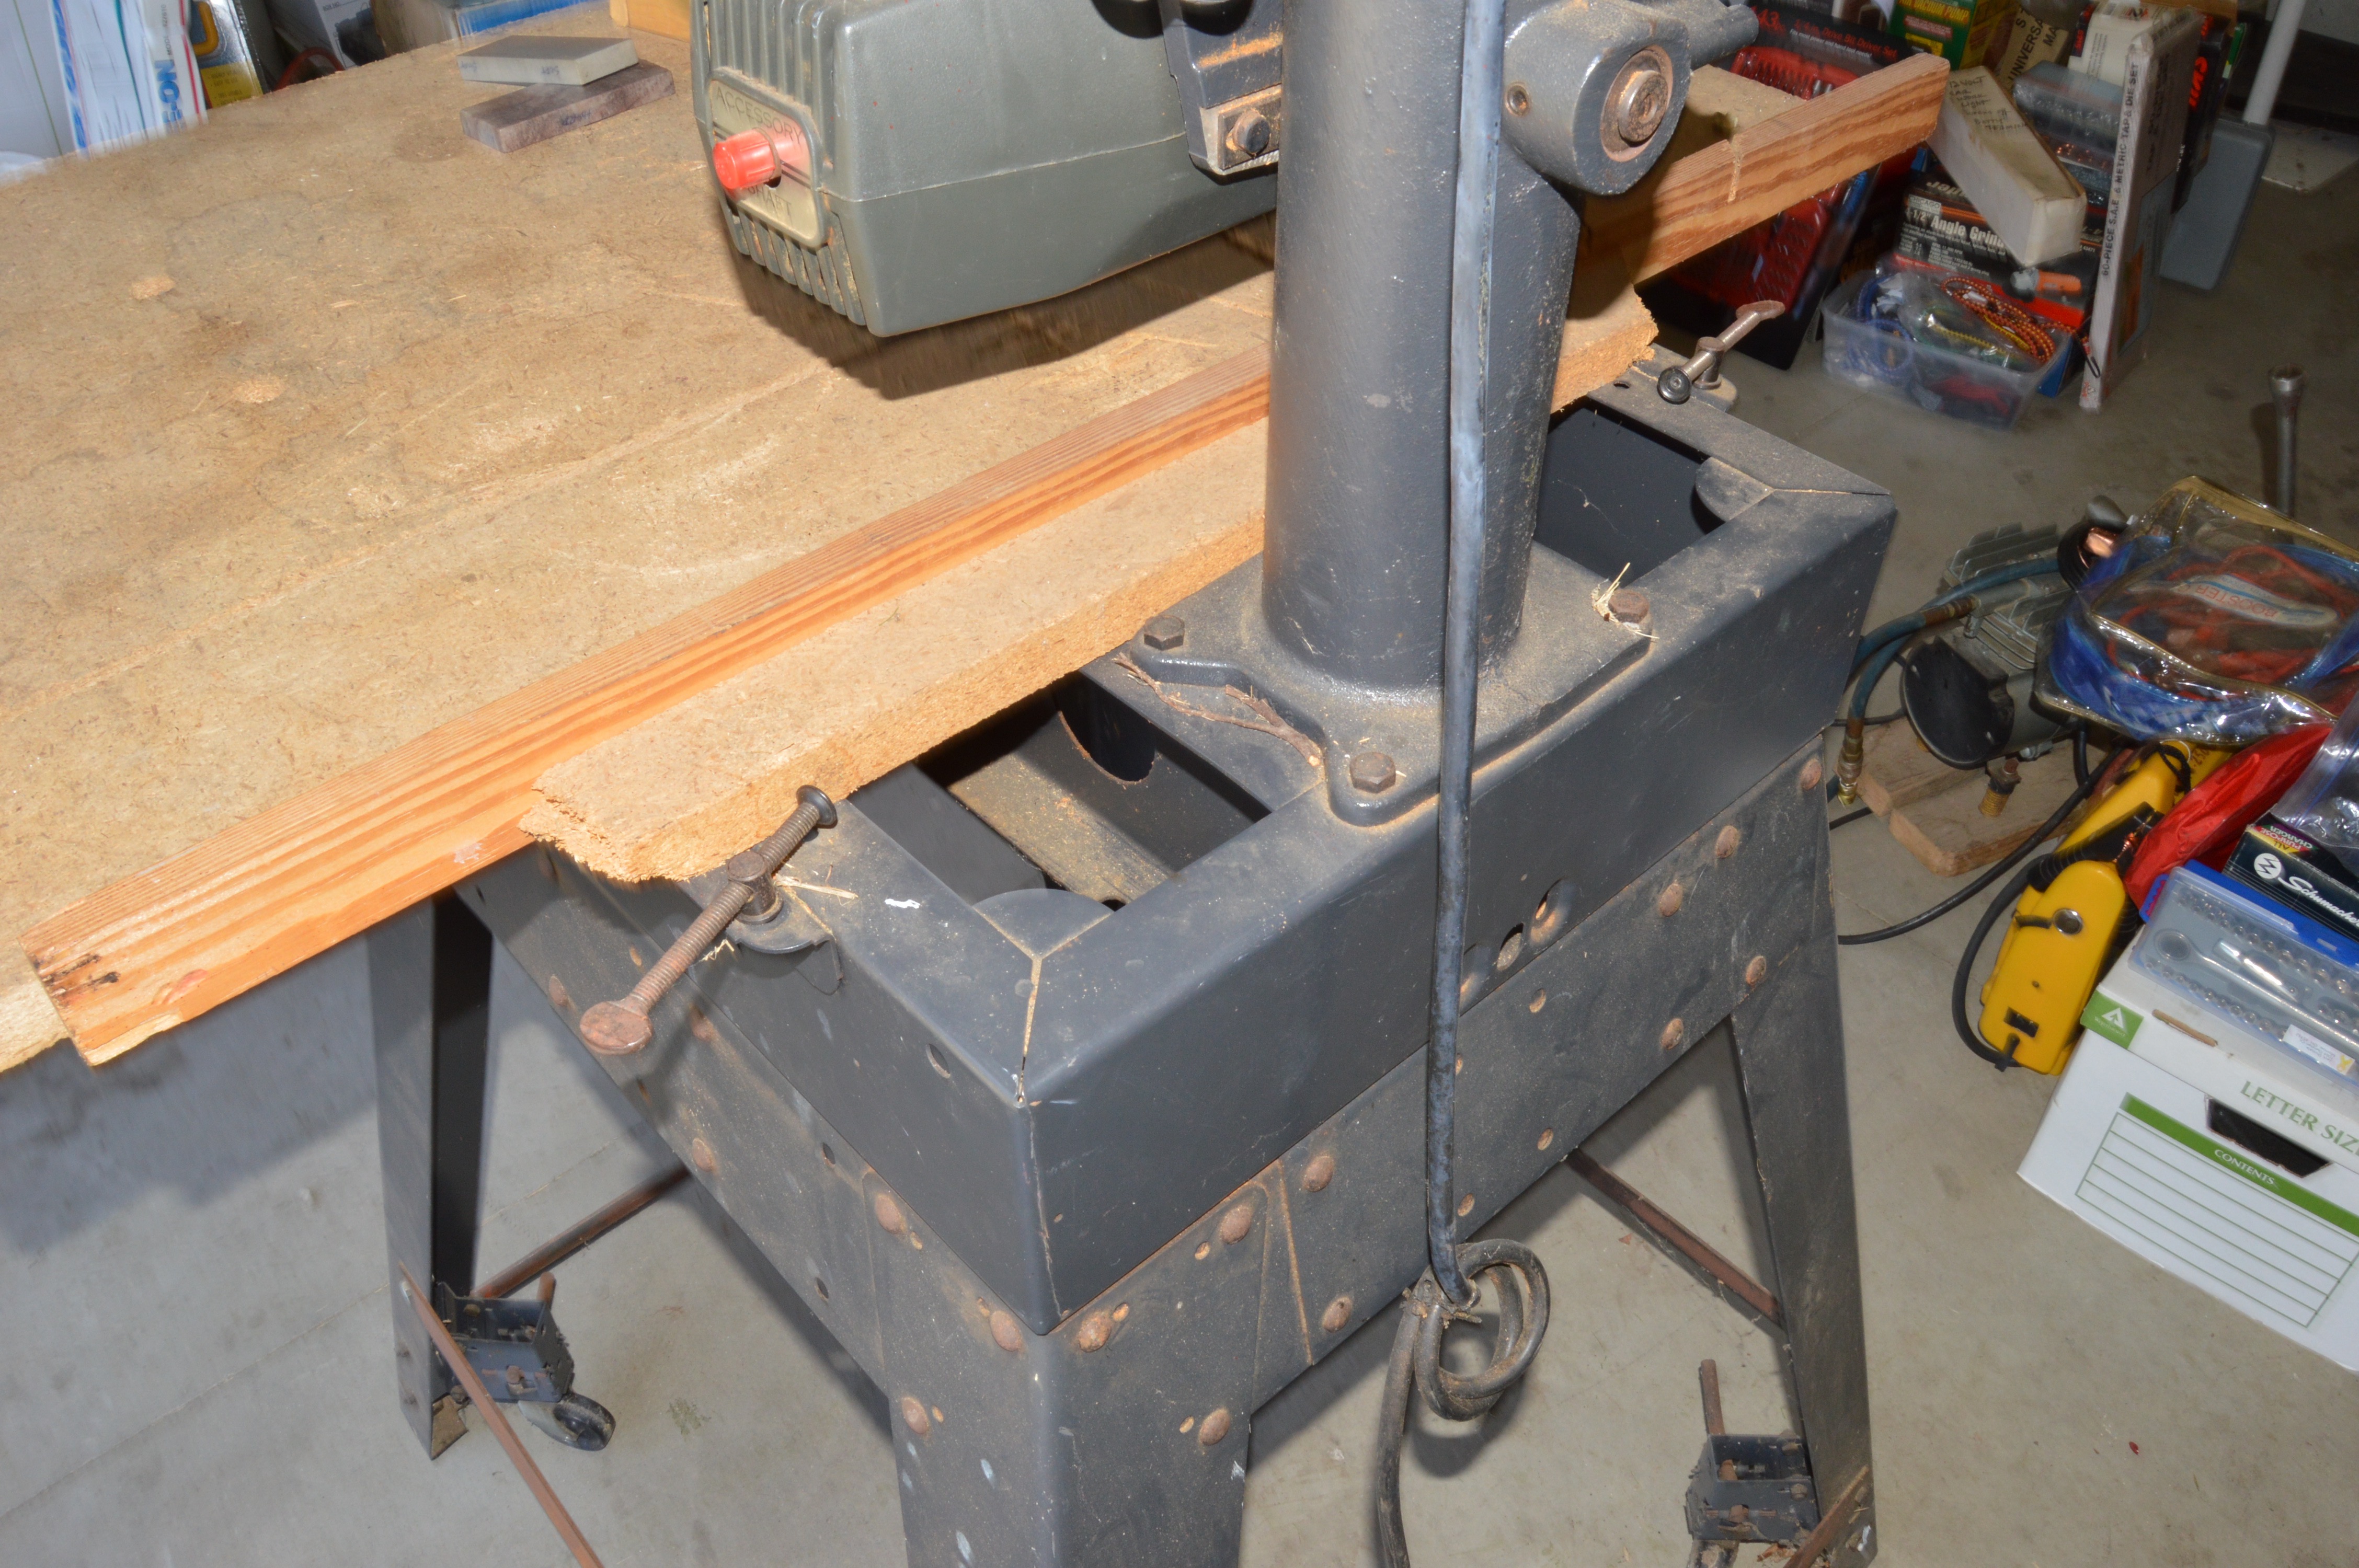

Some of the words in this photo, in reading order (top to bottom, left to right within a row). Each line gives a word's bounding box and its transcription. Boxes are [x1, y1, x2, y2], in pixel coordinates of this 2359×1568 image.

[1914, 0, 1945, 16] VACUUM
[1944, 6, 1969, 22] PUMP
[1823, 28, 1844, 40] Drive
[1845, 34, 1857, 44] Bit
[1858, 39, 1882, 51] Driver
[1883, 47, 1898, 57] Set
[2128, 63, 2139, 85] SET
[2124, 87, 2135, 106] DIE
[716, 87, 803, 144] ACCESSORY
[2114, 143, 2128, 183] METRIC
[748, 186, 792, 216] SHAFT
[1910, 196, 1940, 208] CHICAGO
[1932, 216, 1965, 236] Angle
[2101, 228, 2115, 276] 60-PIECE
[2195, 584, 2279, 618] BOOSTER
[2259, 827, 2302, 850] PURPOSE
[2269, 825, 2314, 849] CHARGER
[2272, 840, 2289, 852] ALL
[2278, 875, 2359, 926] Schumacher
[2240, 1080, 2319, 1131] LETTER
[2215, 1149, 2275, 1185] CONTENTS
